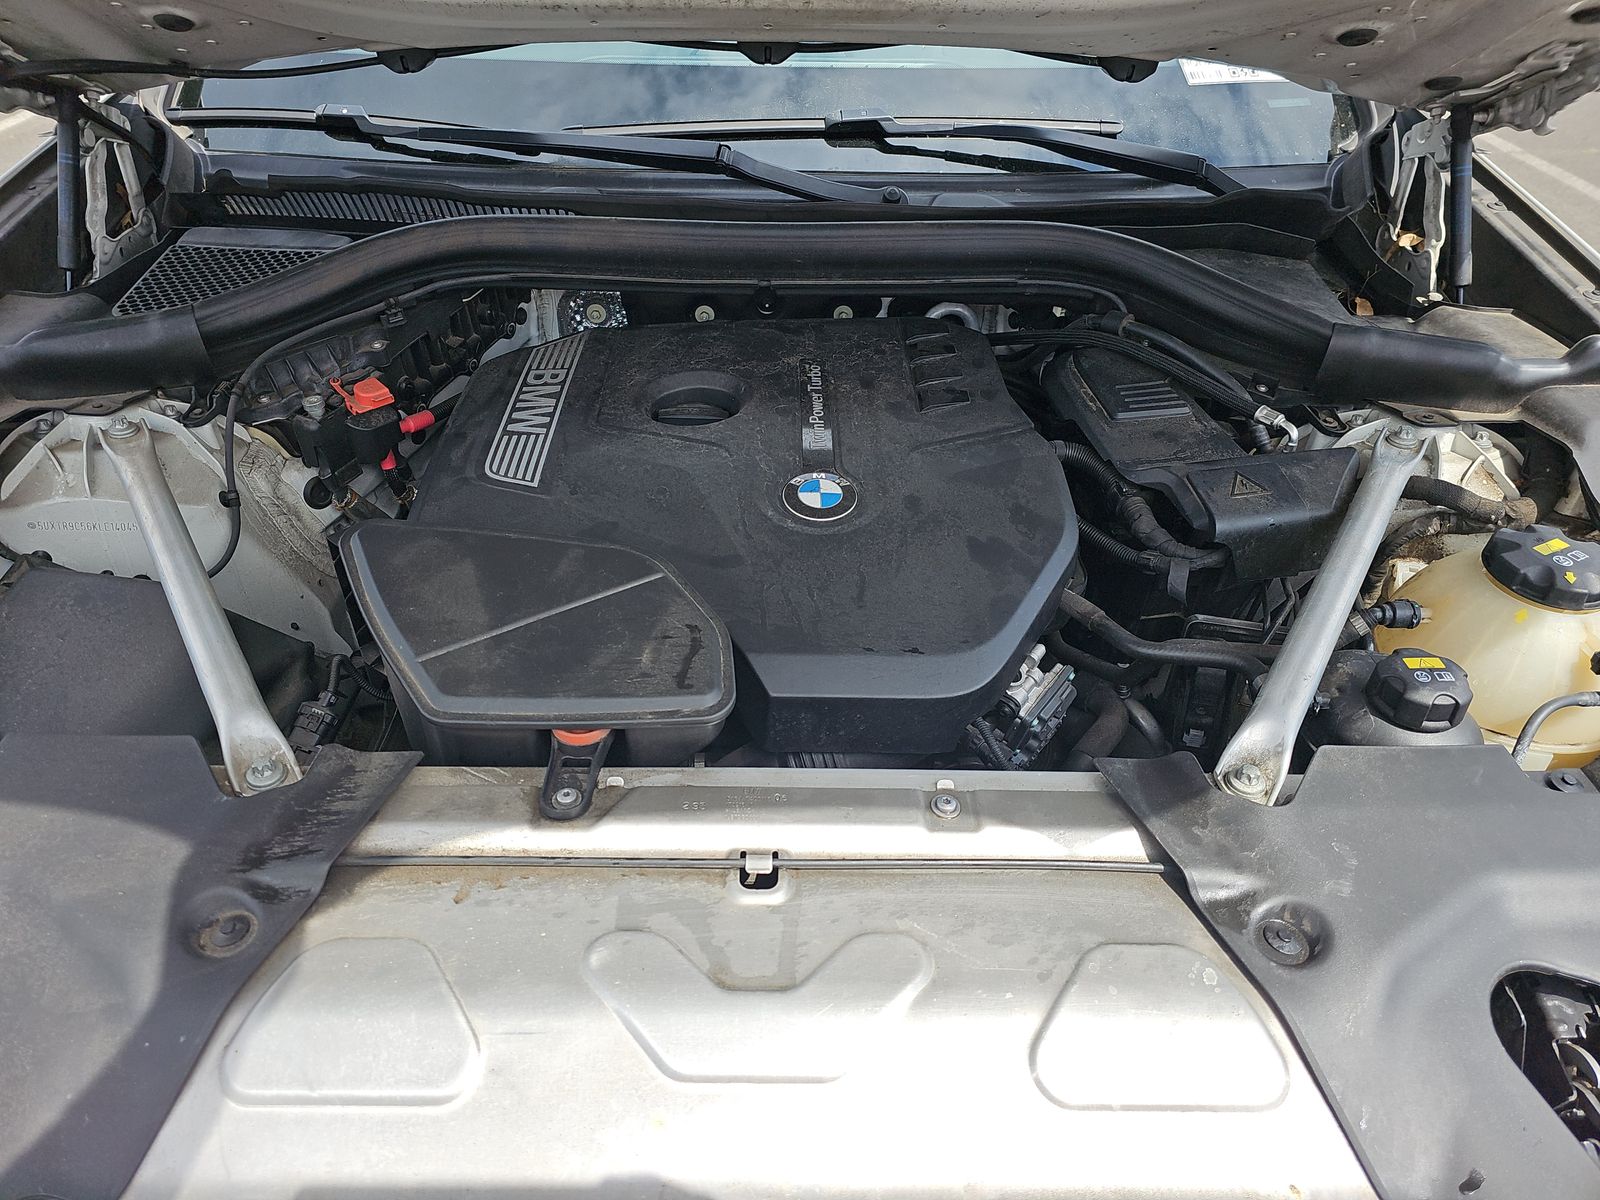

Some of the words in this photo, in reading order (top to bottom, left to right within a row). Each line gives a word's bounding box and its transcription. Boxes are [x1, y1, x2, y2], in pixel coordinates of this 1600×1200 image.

[807, 364, 822, 392] Turbo
[506, 368, 568, 434] BMW
[808, 393, 825, 450] TwinPower
[790, 472, 850, 487] BMW
